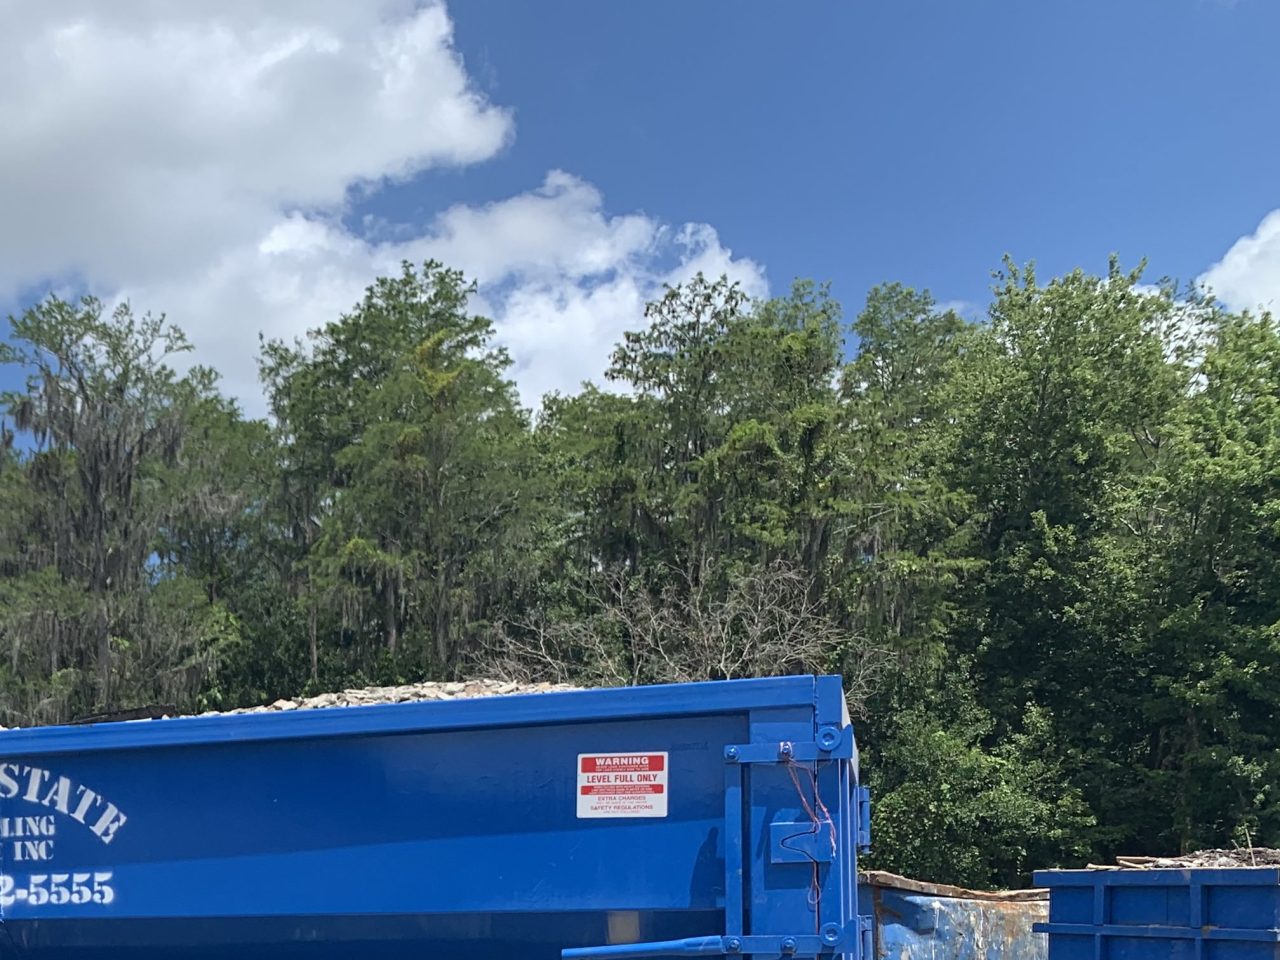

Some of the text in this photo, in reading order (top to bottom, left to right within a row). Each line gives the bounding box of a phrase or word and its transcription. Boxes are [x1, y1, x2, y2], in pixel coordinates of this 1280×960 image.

[595, 756, 649, 765] WARNING
[587, 773, 658, 783] LEVEL FULL ONLY
[13, 840, 54, 861] INC
